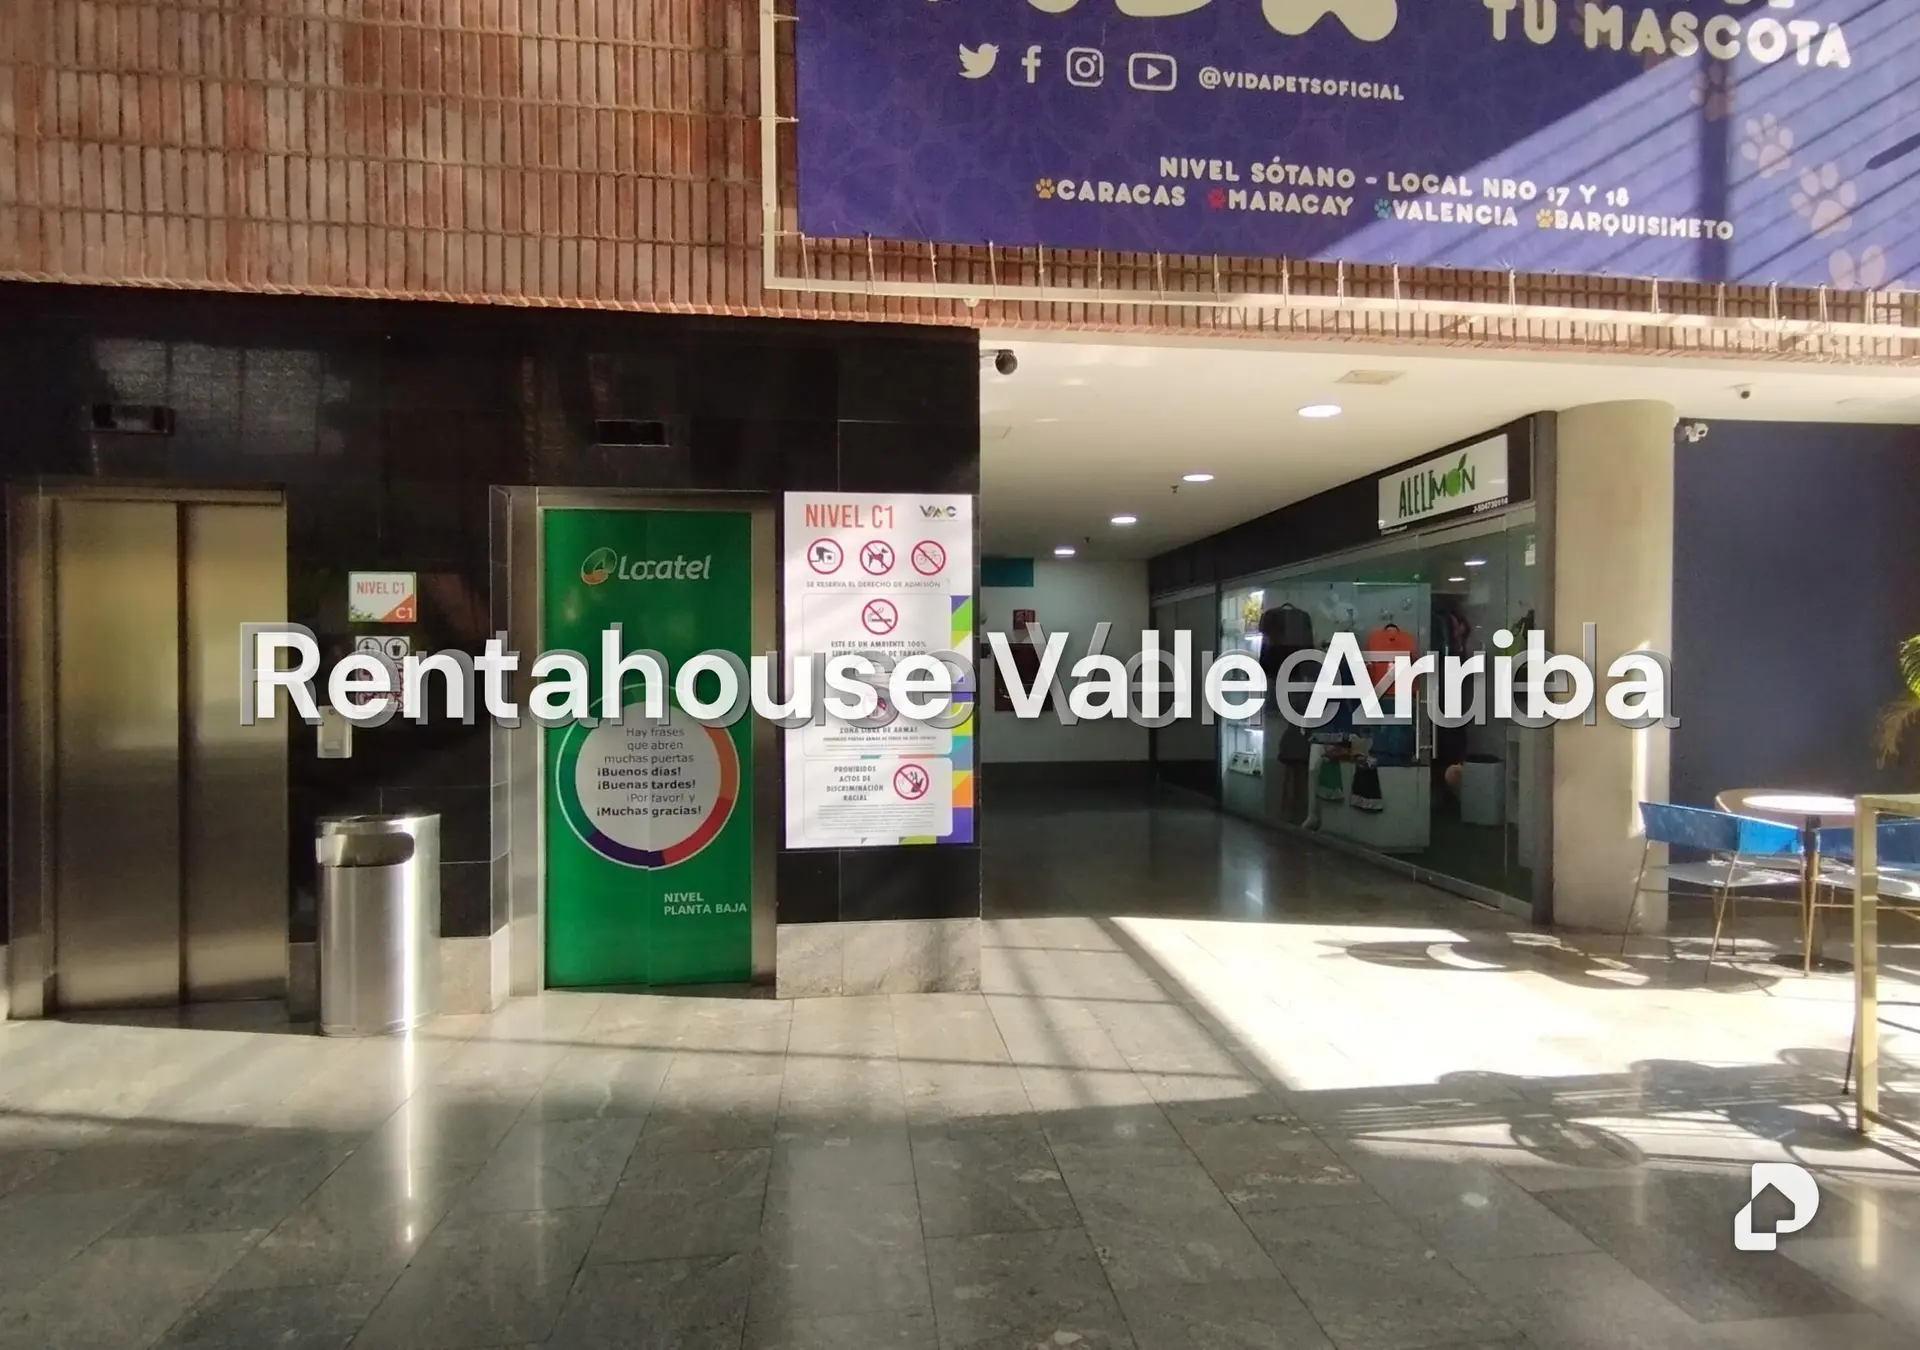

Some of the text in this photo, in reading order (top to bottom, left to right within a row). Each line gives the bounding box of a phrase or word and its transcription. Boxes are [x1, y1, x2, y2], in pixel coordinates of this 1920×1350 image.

[1482, 0, 1852, 68] TU MASCOTA
[1198, 66, 1404, 101] @VIDAPETSOFICIAL
[1160, 156, 1240, 182] NIVEL
[1250, 155, 1356, 188] SÓTANO
[1388, 171, 1473, 197] LOCAL
[1483, 176, 1537, 200] NRO
[1546, 186, 1570, 207] 17
[1579, 184, 1597, 205] Y
[1606, 187, 1629, 207] 18
[1056, 179, 1734, 240] CARACAS MARACAY VALENCIA BARQUISIMETO
[805, 504, 894, 529] NIVEL C1
[618, 555, 711, 580] Locatel
[356, 581, 405, 595] NIVEL C1
[816, 580, 847, 588] RESERVA
[396, 607, 413, 619] C1
[626, 727, 685, 738] Hay frases
[627, 740, 684, 752] que abren
[604, 754, 694, 765] muchas puertas
[597, 767, 648, 777] ¡Buenos
[597, 779, 696, 790] ¡Buenas tardes!
[626, 793, 696, 803] ¡Por favor! y
[597, 805, 702, 818] ¡Muchas gracias!
[664, 892, 704, 903] NIVEL
[664, 902, 747, 915] PLANTA BAJA
